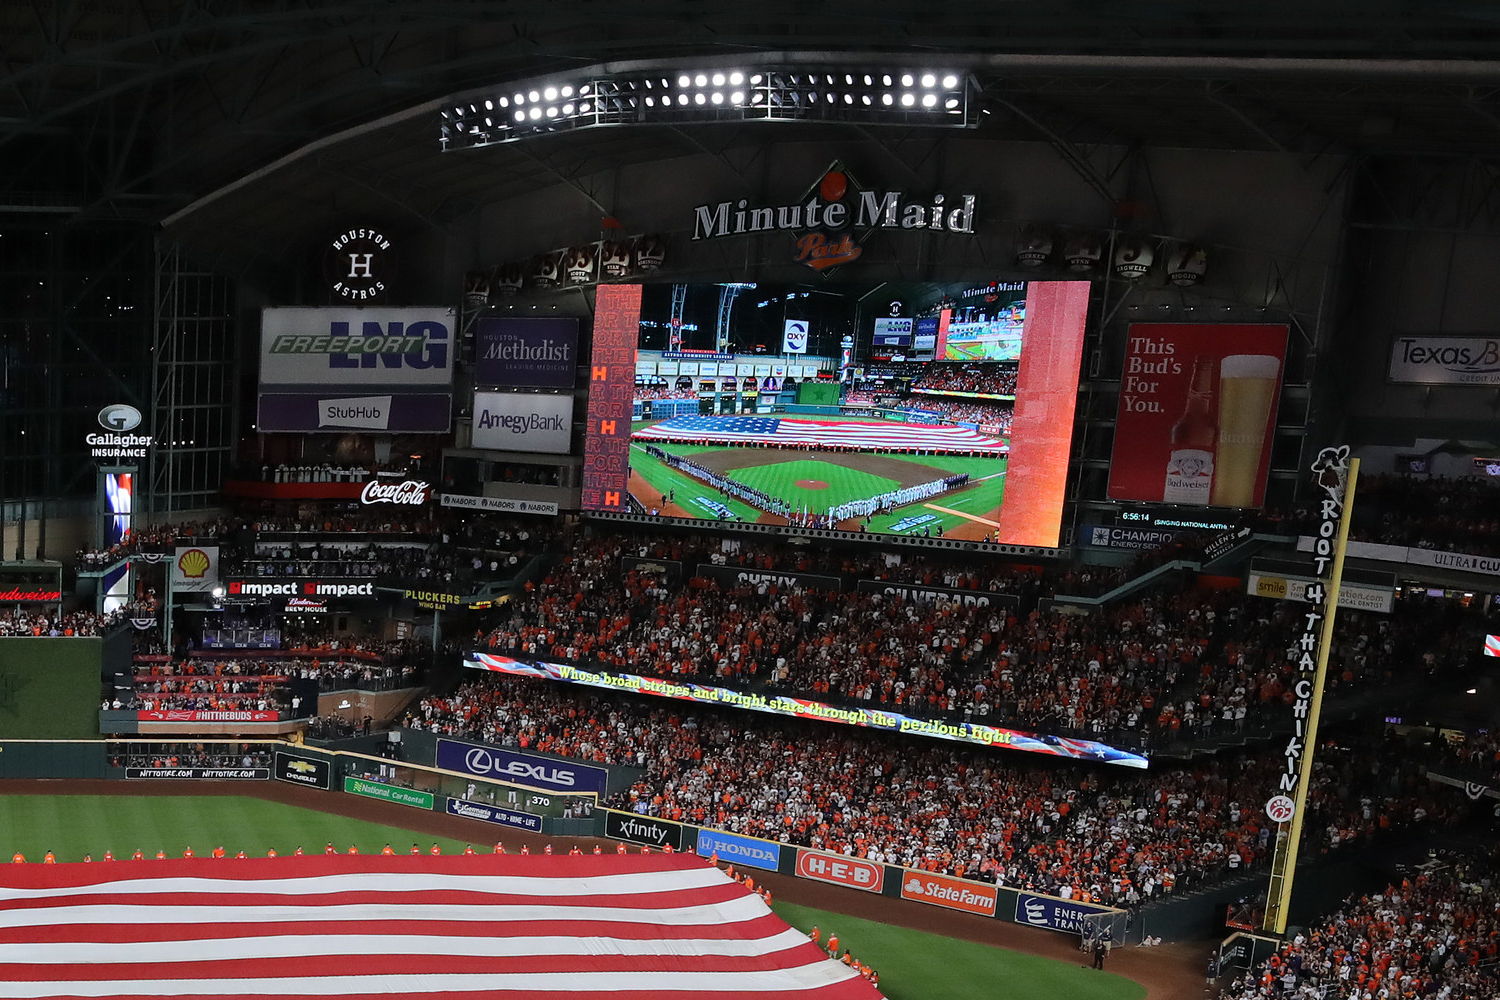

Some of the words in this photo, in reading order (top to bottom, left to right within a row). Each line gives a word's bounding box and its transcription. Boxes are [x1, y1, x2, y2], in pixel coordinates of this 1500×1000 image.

[692, 197, 846, 240] Minute
[855, 191, 976, 234] Maid
[333, 229, 390, 250] HOUSTON
[797, 233, 860, 265] Park
[349, 254, 373, 277] H
[334, 281, 385, 299] ASTROS
[274, 335, 422, 353] FREEPORT
[329, 321, 447, 369] LNG
[485, 341, 569, 361] Methodist
[1131, 337, 1175, 354] This
[1401, 339, 1471, 364] Texas
[1128, 357, 1182, 375] Bud's
[1125, 376, 1159, 394] For
[328, 406, 380, 419] StubHub
[1124, 395, 1165, 413] You.
[478, 409, 566, 433] AmegyBank
[86, 434, 152, 448] Gallagher
[92, 449, 146, 457] INSURANCE
[361, 480, 429, 505] Coca-Cola
[1167, 478, 1209, 489] Budweiser
[452, 497, 476, 506] NABORS
[489, 500, 514, 509] NABORS
[528, 504, 554, 512] NABORS
[1123, 512, 1150, 521] 6:56:14
[1181, 521, 1209, 529] NATIONAL
[1314, 500, 1339, 575] ROOT
[1435, 553, 1470, 567] ULTRA
[241, 581, 297, 596] impact
[316, 582, 372, 596] impact
[1259, 581, 1285, 594] smile
[1307, 585, 1323, 604] 4
[406, 590, 460, 604] PLUCKERS
[1358, 600, 1382, 608] DENTIST
[1299, 613, 1322, 671] THA
[559, 667, 600, 683] Whose
[603, 672, 641, 690] broad
[644, 680, 690, 697] stripes
[693, 686, 719, 700] and
[722, 689, 767, 709] bright
[770, 701, 804, 713] stars
[808, 703, 868, 724] through
[872, 711, 896, 728] the
[900, 718, 967, 738] perilous
[971, 726, 1011, 744] fight
[196, 711, 251, 720] #HITTHEBUDS
[1279, 680, 1311, 791] CHIKIN
[140, 770, 193, 778] NITTOTIRE.COM
[202, 770, 255, 778] NITTOTIRE.COM
[494, 758, 575, 786] LEXUS
[361, 784, 390, 797] National
[392, 791, 403, 799] Car
[403, 794, 424, 804] Rental
[531, 796, 550, 806] 370
[620, 819, 668, 841] xfinity
[713, 841, 777, 862] HONDA
[809, 858, 871, 884] H-E-B
